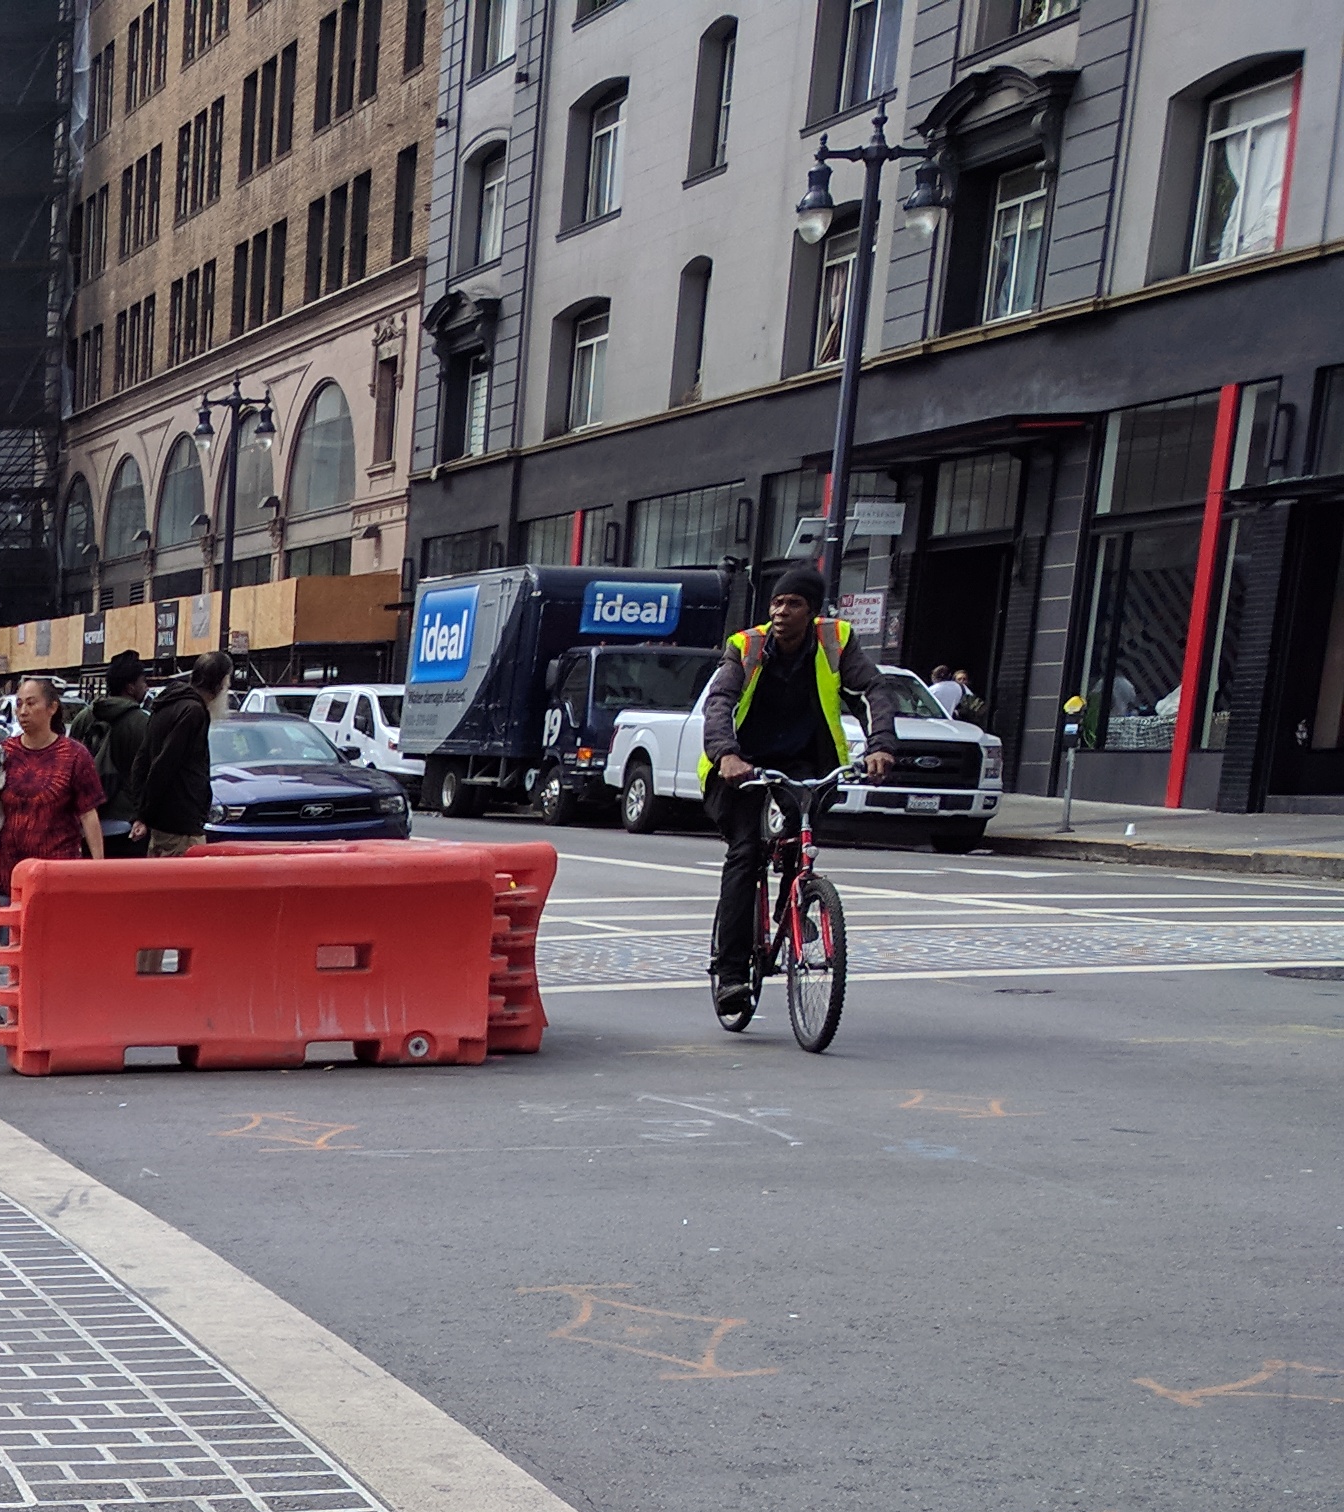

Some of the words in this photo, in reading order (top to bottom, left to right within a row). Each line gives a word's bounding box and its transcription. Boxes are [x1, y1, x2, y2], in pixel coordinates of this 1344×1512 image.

[592, 593, 669, 624] ideal
[420, 609, 468, 663] ideal
[543, 708, 562, 747] 19
